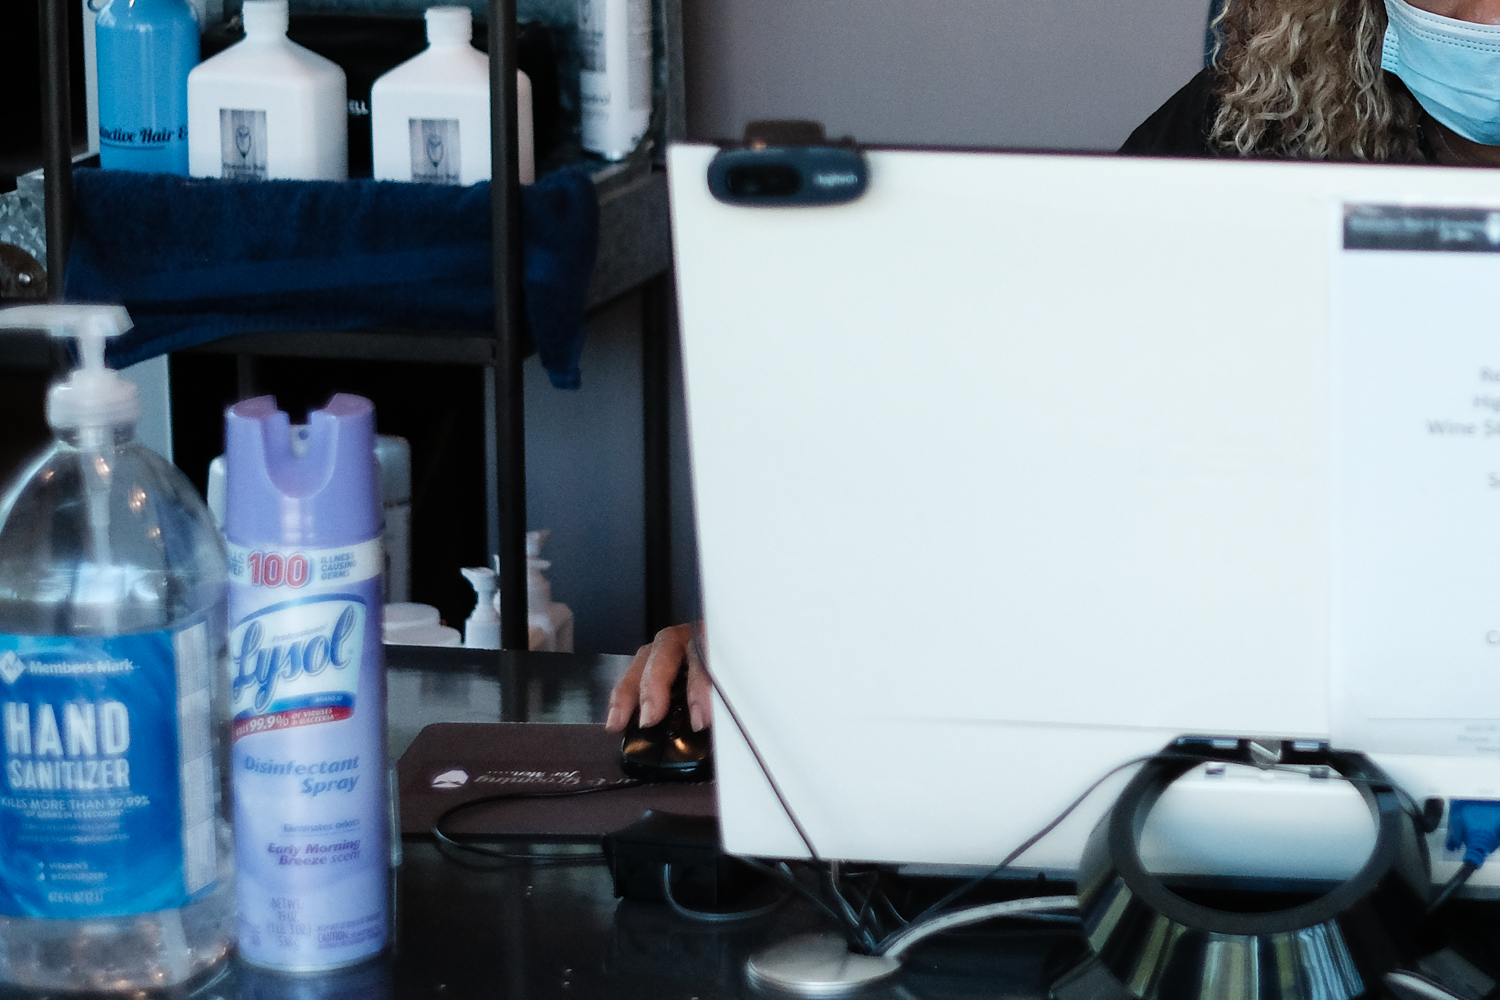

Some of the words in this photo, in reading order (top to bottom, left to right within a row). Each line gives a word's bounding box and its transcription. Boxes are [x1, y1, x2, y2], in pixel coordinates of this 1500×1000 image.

[140, 126, 174, 143] Hair
[1427, 419, 1476, 435] Wine
[248, 551, 310, 588] 100
[96, 658, 134, 674] Mark
[232, 604, 357, 713] Lysol
[4, 701, 130, 755] HAND
[250, 714, 289, 733] 99.9%
[8, 758, 130, 790] SANITIZER
[244, 754, 360, 776] Disinfectant
[301, 774, 360, 797] Spray
[30, 798, 65, 810] MORE
[69, 799, 104, 810] THAN
[107, 795, 150, 808] 99.99%
[268, 842, 301, 856] Early
[305, 839, 360, 855] Morning
[279, 855, 327, 866] Breeze
[330, 851, 360, 864] scent
